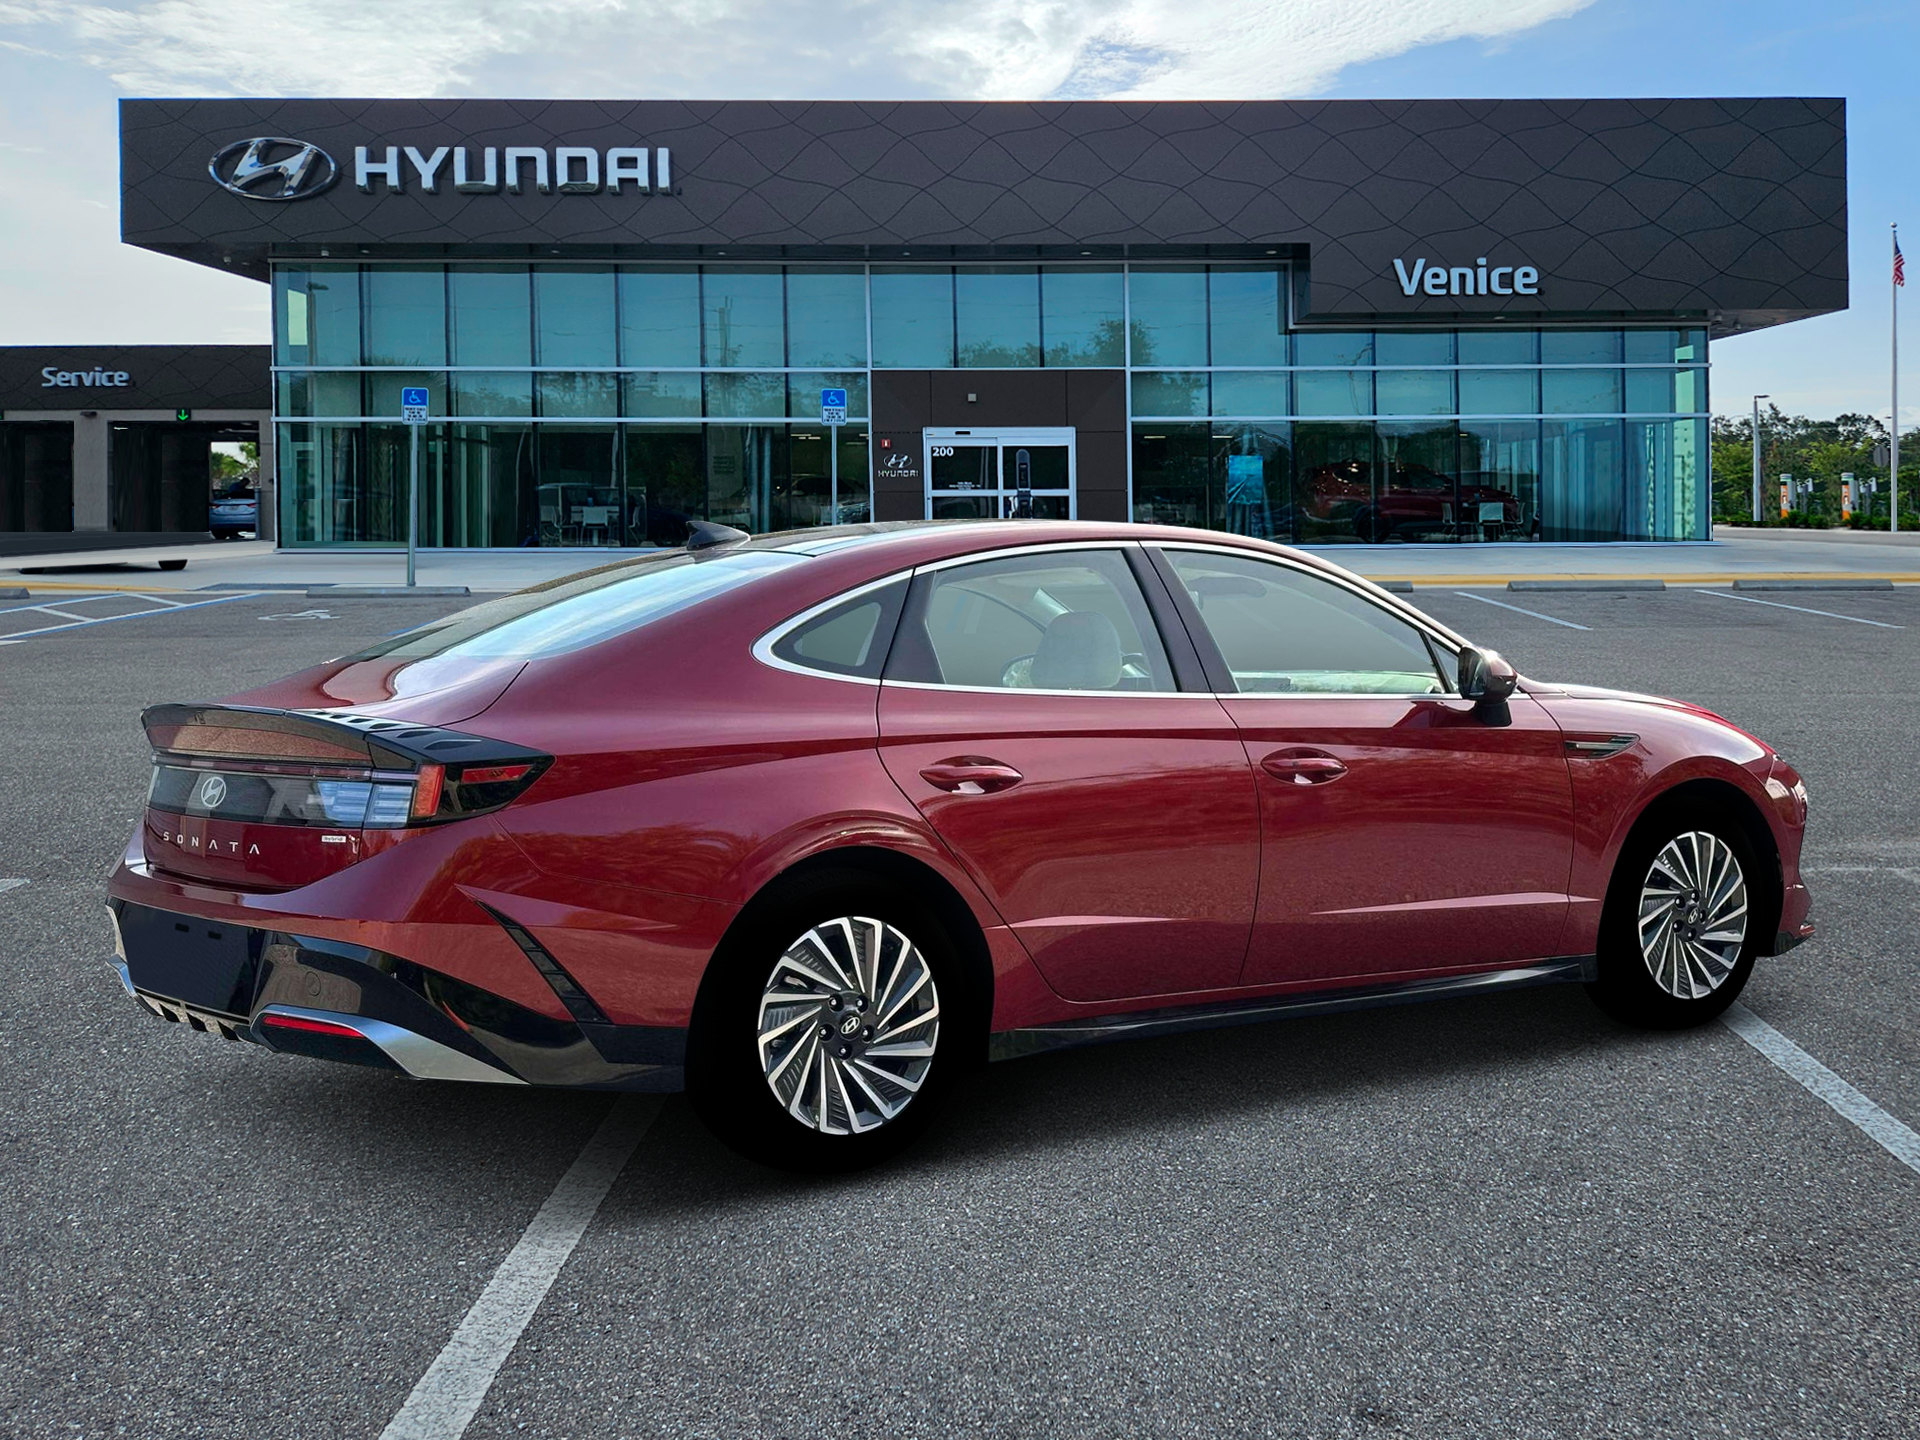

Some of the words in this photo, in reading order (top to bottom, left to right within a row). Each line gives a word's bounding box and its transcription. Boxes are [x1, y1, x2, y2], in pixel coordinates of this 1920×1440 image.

[355, 146, 671, 194] HYUNDAI
[1393, 257, 1539, 296] Venice
[41, 366, 130, 387] Service
[932, 446, 954, 457] 200
[877, 469, 919, 478] HYUNDAI
[162, 831, 260, 855] SONATA
